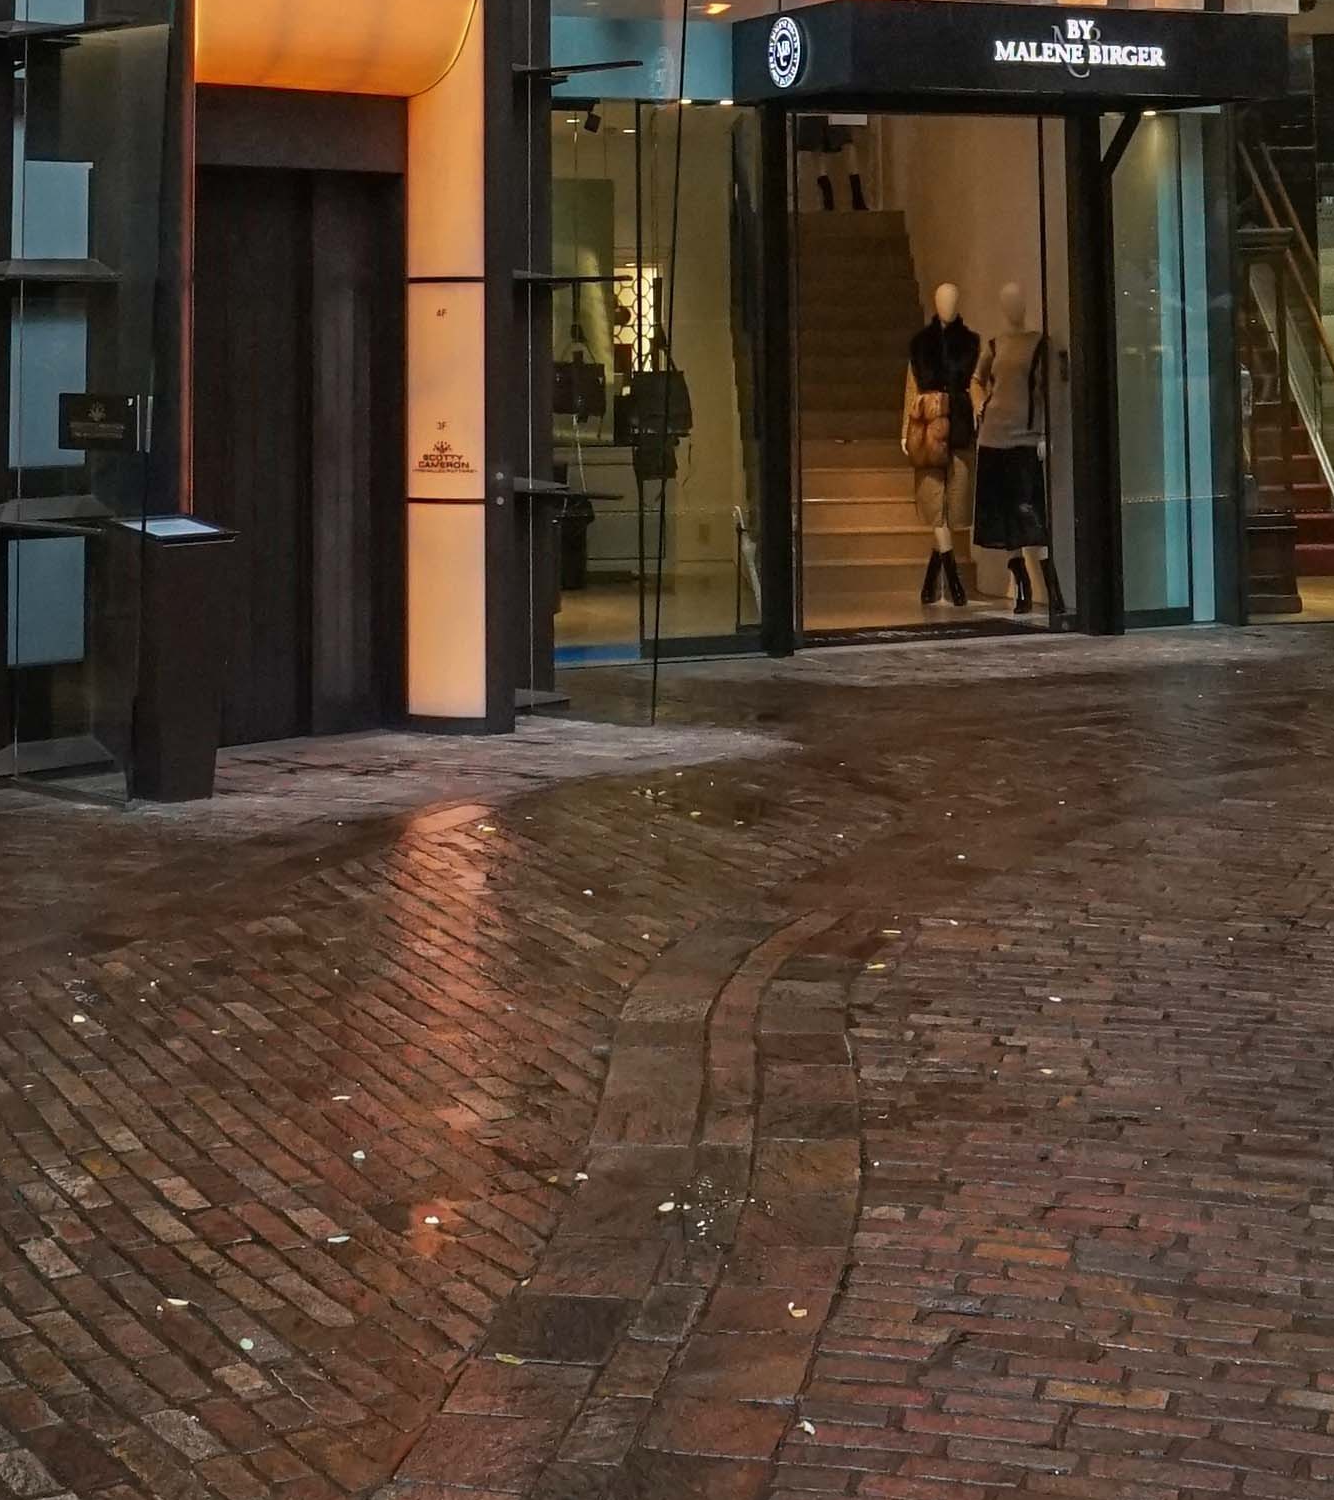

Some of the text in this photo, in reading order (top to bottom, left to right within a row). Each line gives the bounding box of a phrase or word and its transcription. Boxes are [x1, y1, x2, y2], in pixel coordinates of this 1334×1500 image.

[1066, 19, 1095, 40] BY
[994, 40, 1167, 67] MALENE BIRGER
[422, 453, 464, 461] SCOTTY
[418, 461, 470, 469] CAMERON
